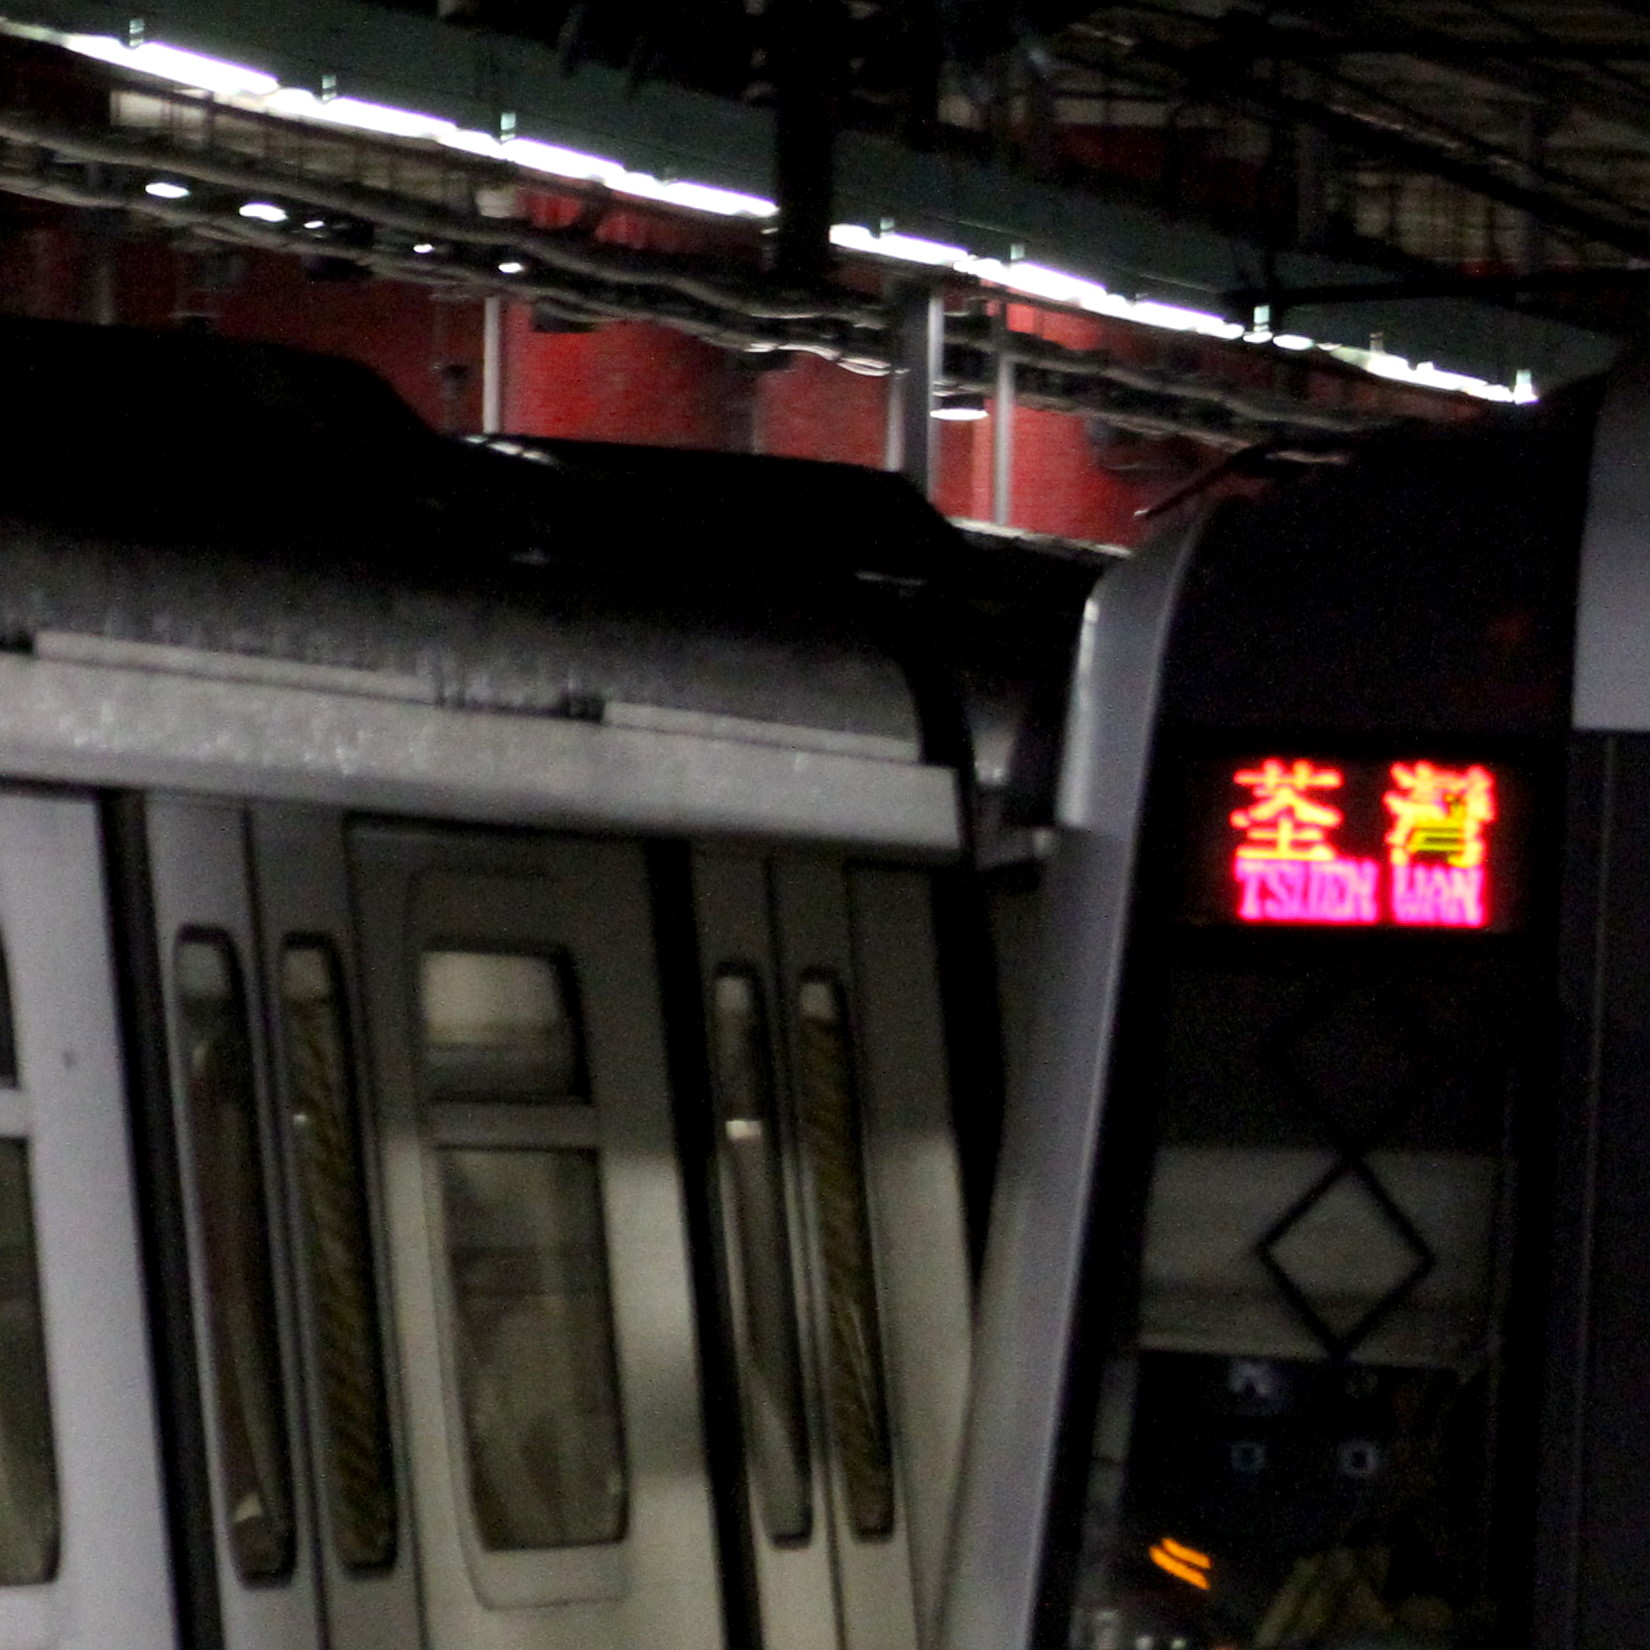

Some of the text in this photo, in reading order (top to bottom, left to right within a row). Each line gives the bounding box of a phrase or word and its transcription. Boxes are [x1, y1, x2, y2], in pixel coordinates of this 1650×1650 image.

[1230, 758, 1496, 867] 荃灣
[1235, 858, 1488, 928] TSUEN WAN
